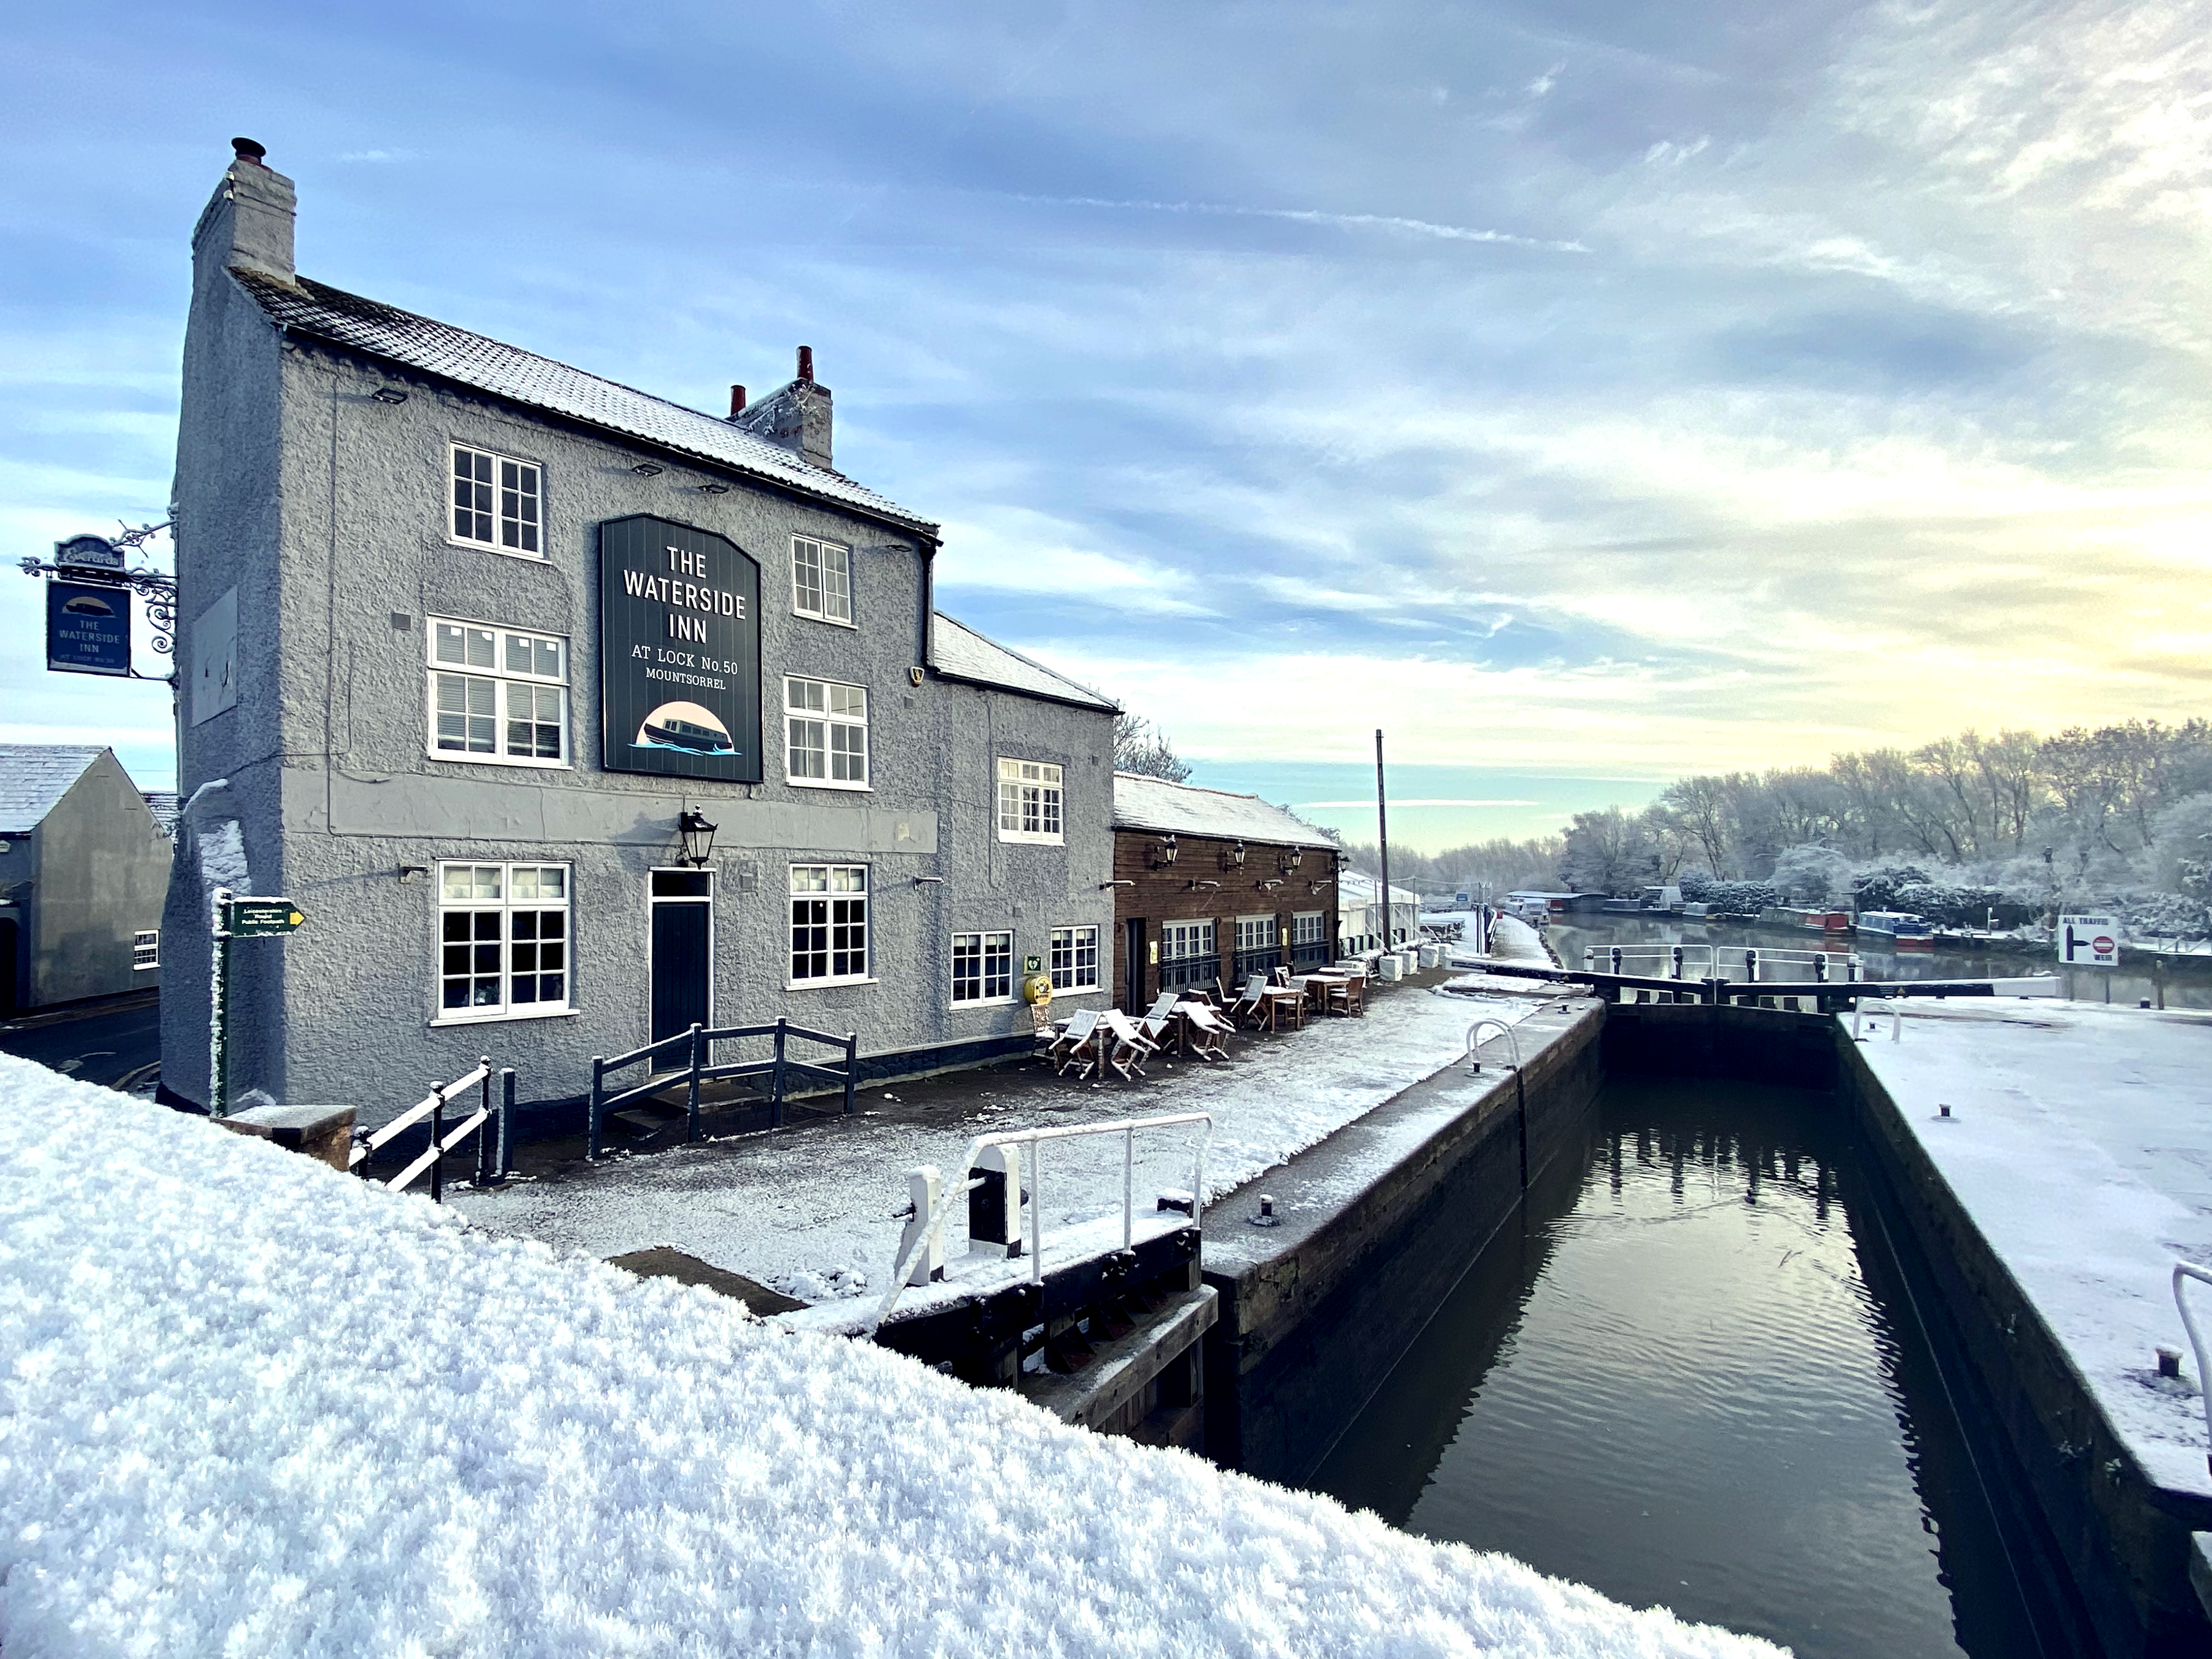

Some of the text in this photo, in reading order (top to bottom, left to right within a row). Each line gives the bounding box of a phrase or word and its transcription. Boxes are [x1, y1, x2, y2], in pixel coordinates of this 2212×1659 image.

[666, 545, 707, 579] THE
[623, 569, 746, 620] WATERSIDE
[59, 630, 120, 644] WATERSIDE
[80, 620, 100, 631] THE
[668, 614, 707, 644] INN
[80, 643, 100, 653] INN
[631, 644, 651, 660] AT
[657, 648, 695, 668] LOCK
[646, 667, 726, 690] MOUNTSORREL
